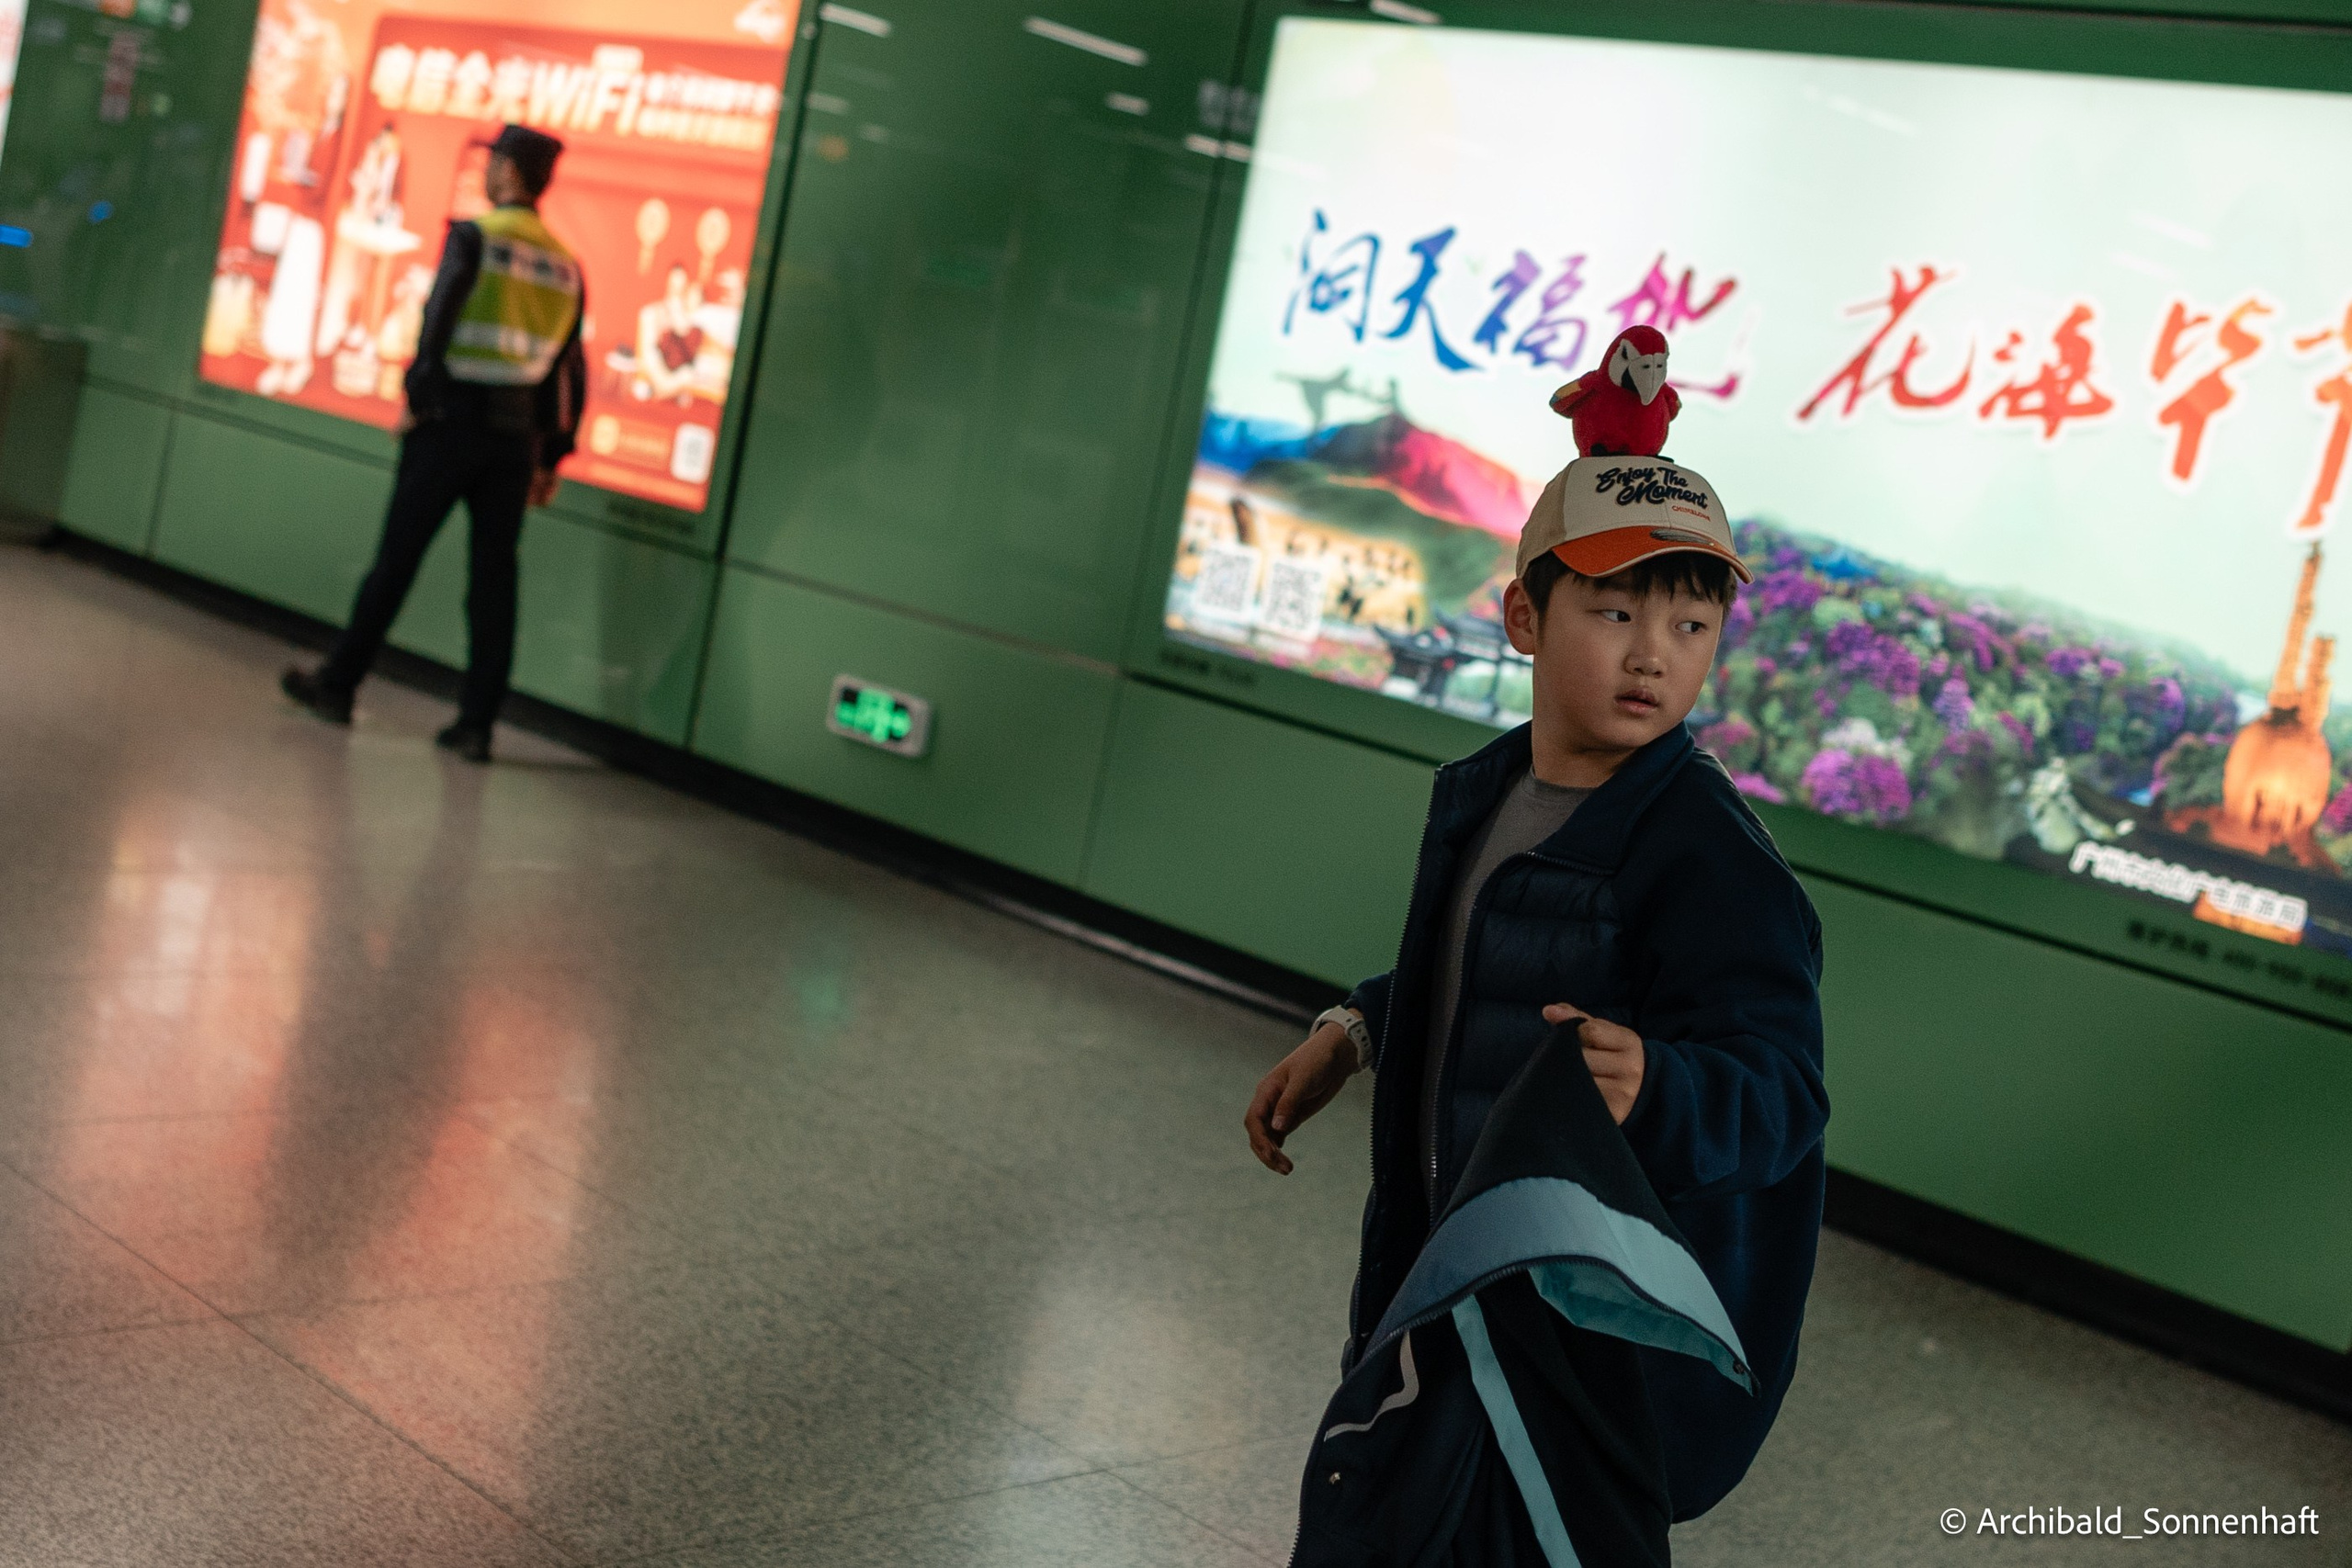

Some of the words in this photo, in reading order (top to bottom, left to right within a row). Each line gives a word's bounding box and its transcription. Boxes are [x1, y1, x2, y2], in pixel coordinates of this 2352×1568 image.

[1595, 467, 1657, 493] Enjoy
[1657, 467, 1689, 488] The
[1616, 479, 1709, 509] Moment
